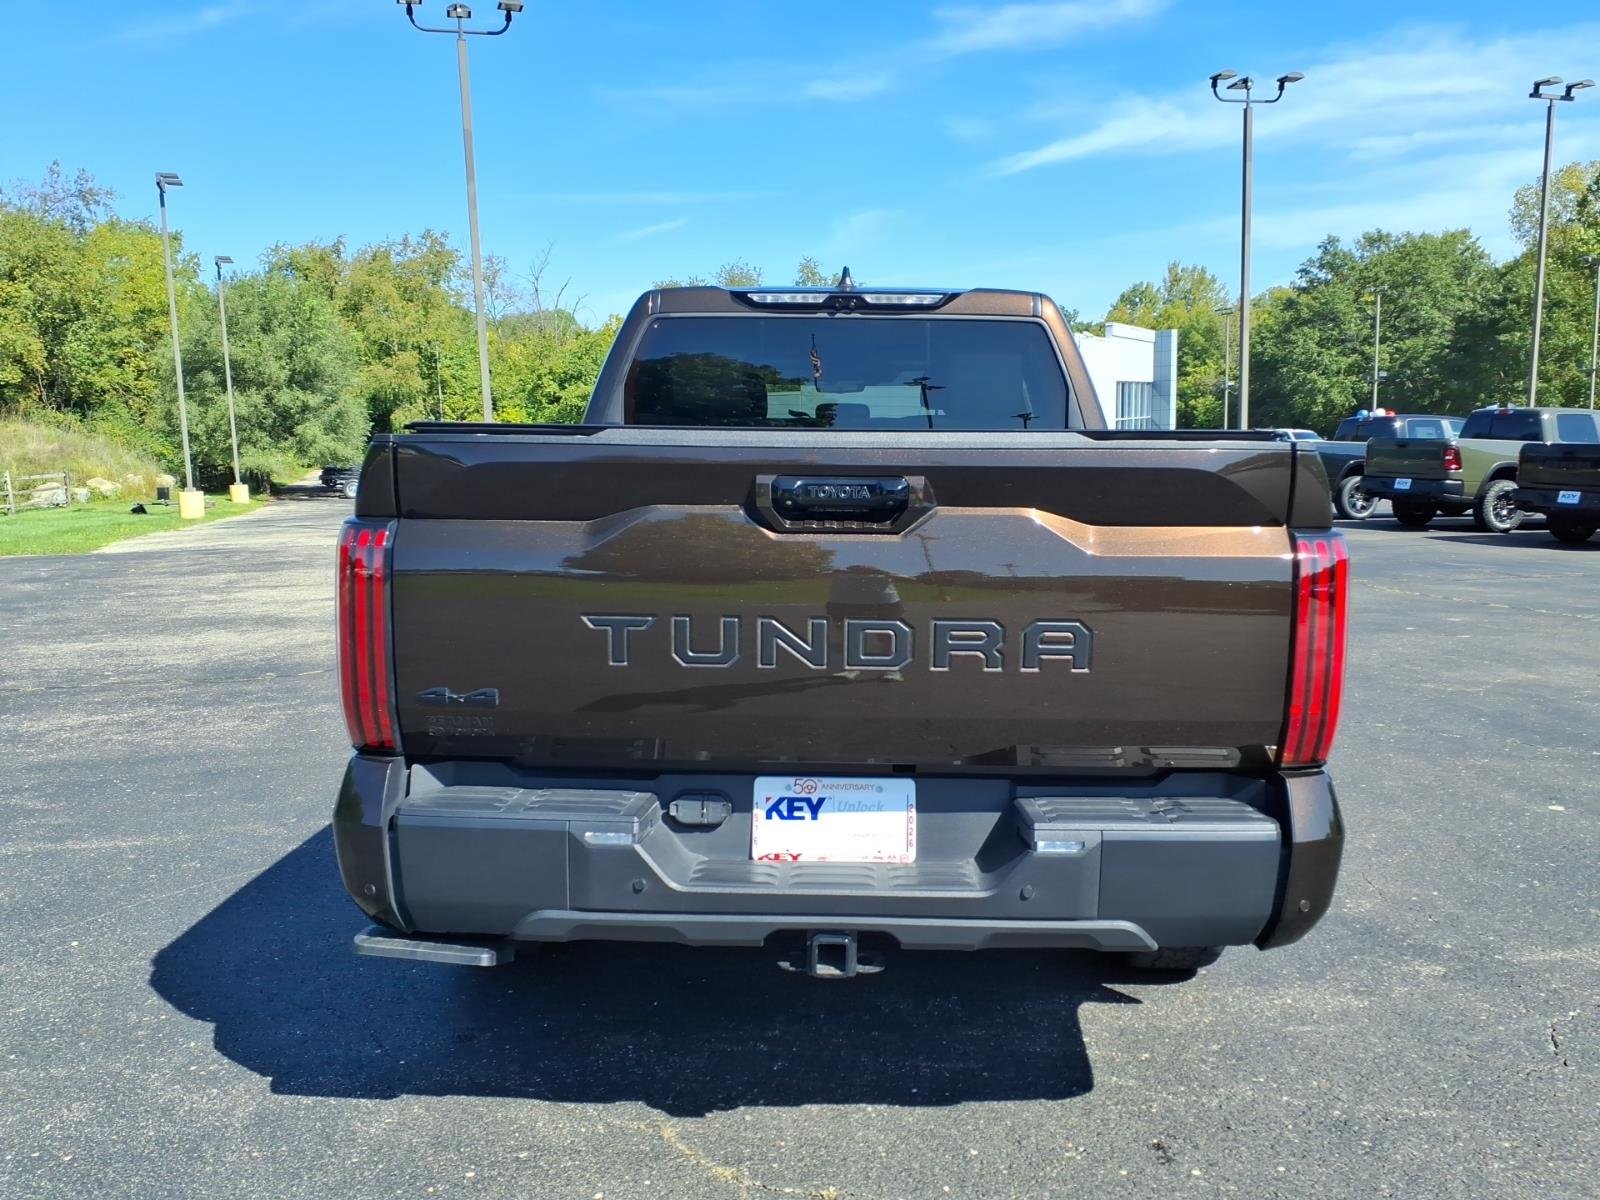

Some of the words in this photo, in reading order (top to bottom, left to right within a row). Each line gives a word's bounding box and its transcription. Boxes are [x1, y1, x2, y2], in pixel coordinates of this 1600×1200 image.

[807, 485, 871, 499] TOYOTA
[580, 612, 1094, 673] TUNDRA
[793, 778, 818, 795] 50
[821, 783, 876, 792] ANNIVERSARY
[765, 796, 826, 820] KEY
[837, 800, 885, 812] Unlock
